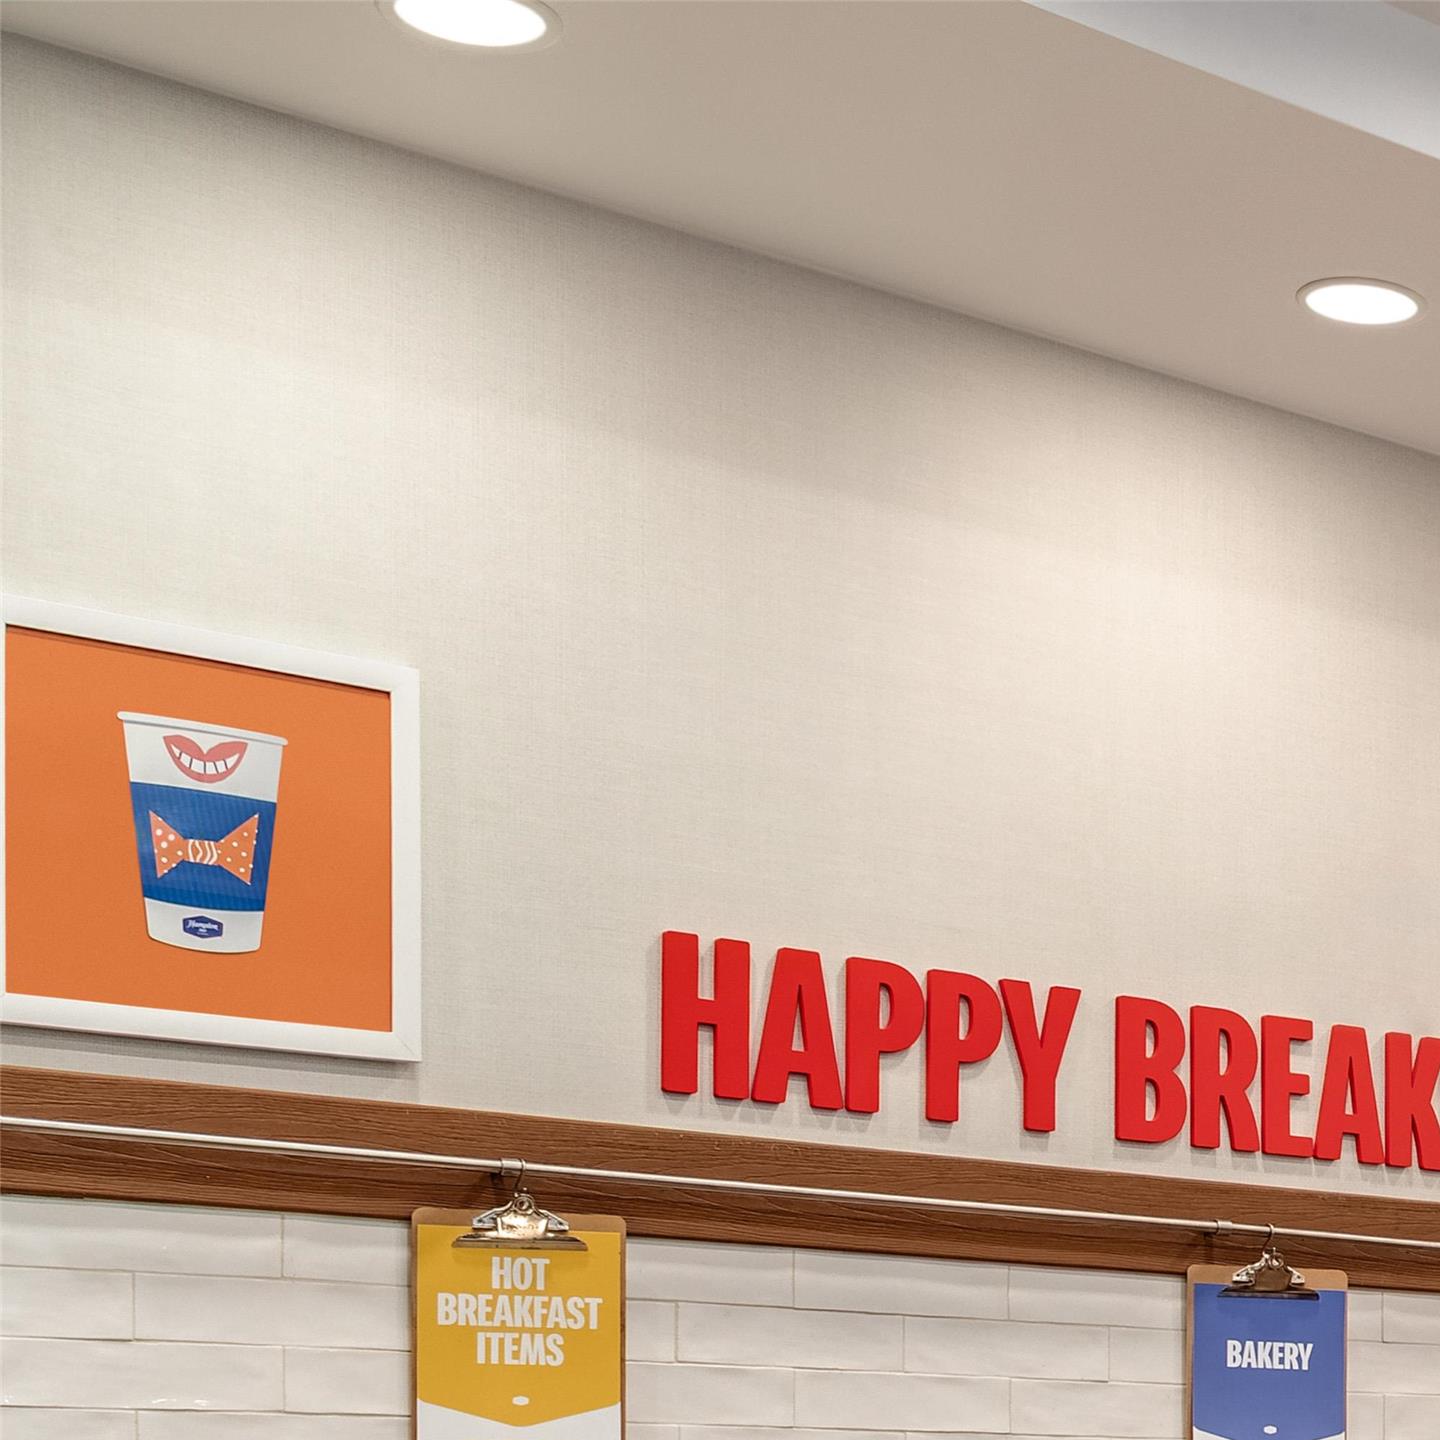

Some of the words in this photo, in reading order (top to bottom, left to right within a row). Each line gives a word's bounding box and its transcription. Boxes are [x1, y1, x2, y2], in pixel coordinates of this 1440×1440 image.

[661, 930, 1082, 1133] HAPPY
[491, 1256, 551, 1291] HOT
[436, 1292, 603, 1330] BREAKFAST
[475, 1332, 565, 1367] ITEMS
[1226, 1339, 1314, 1371] BAKERY
